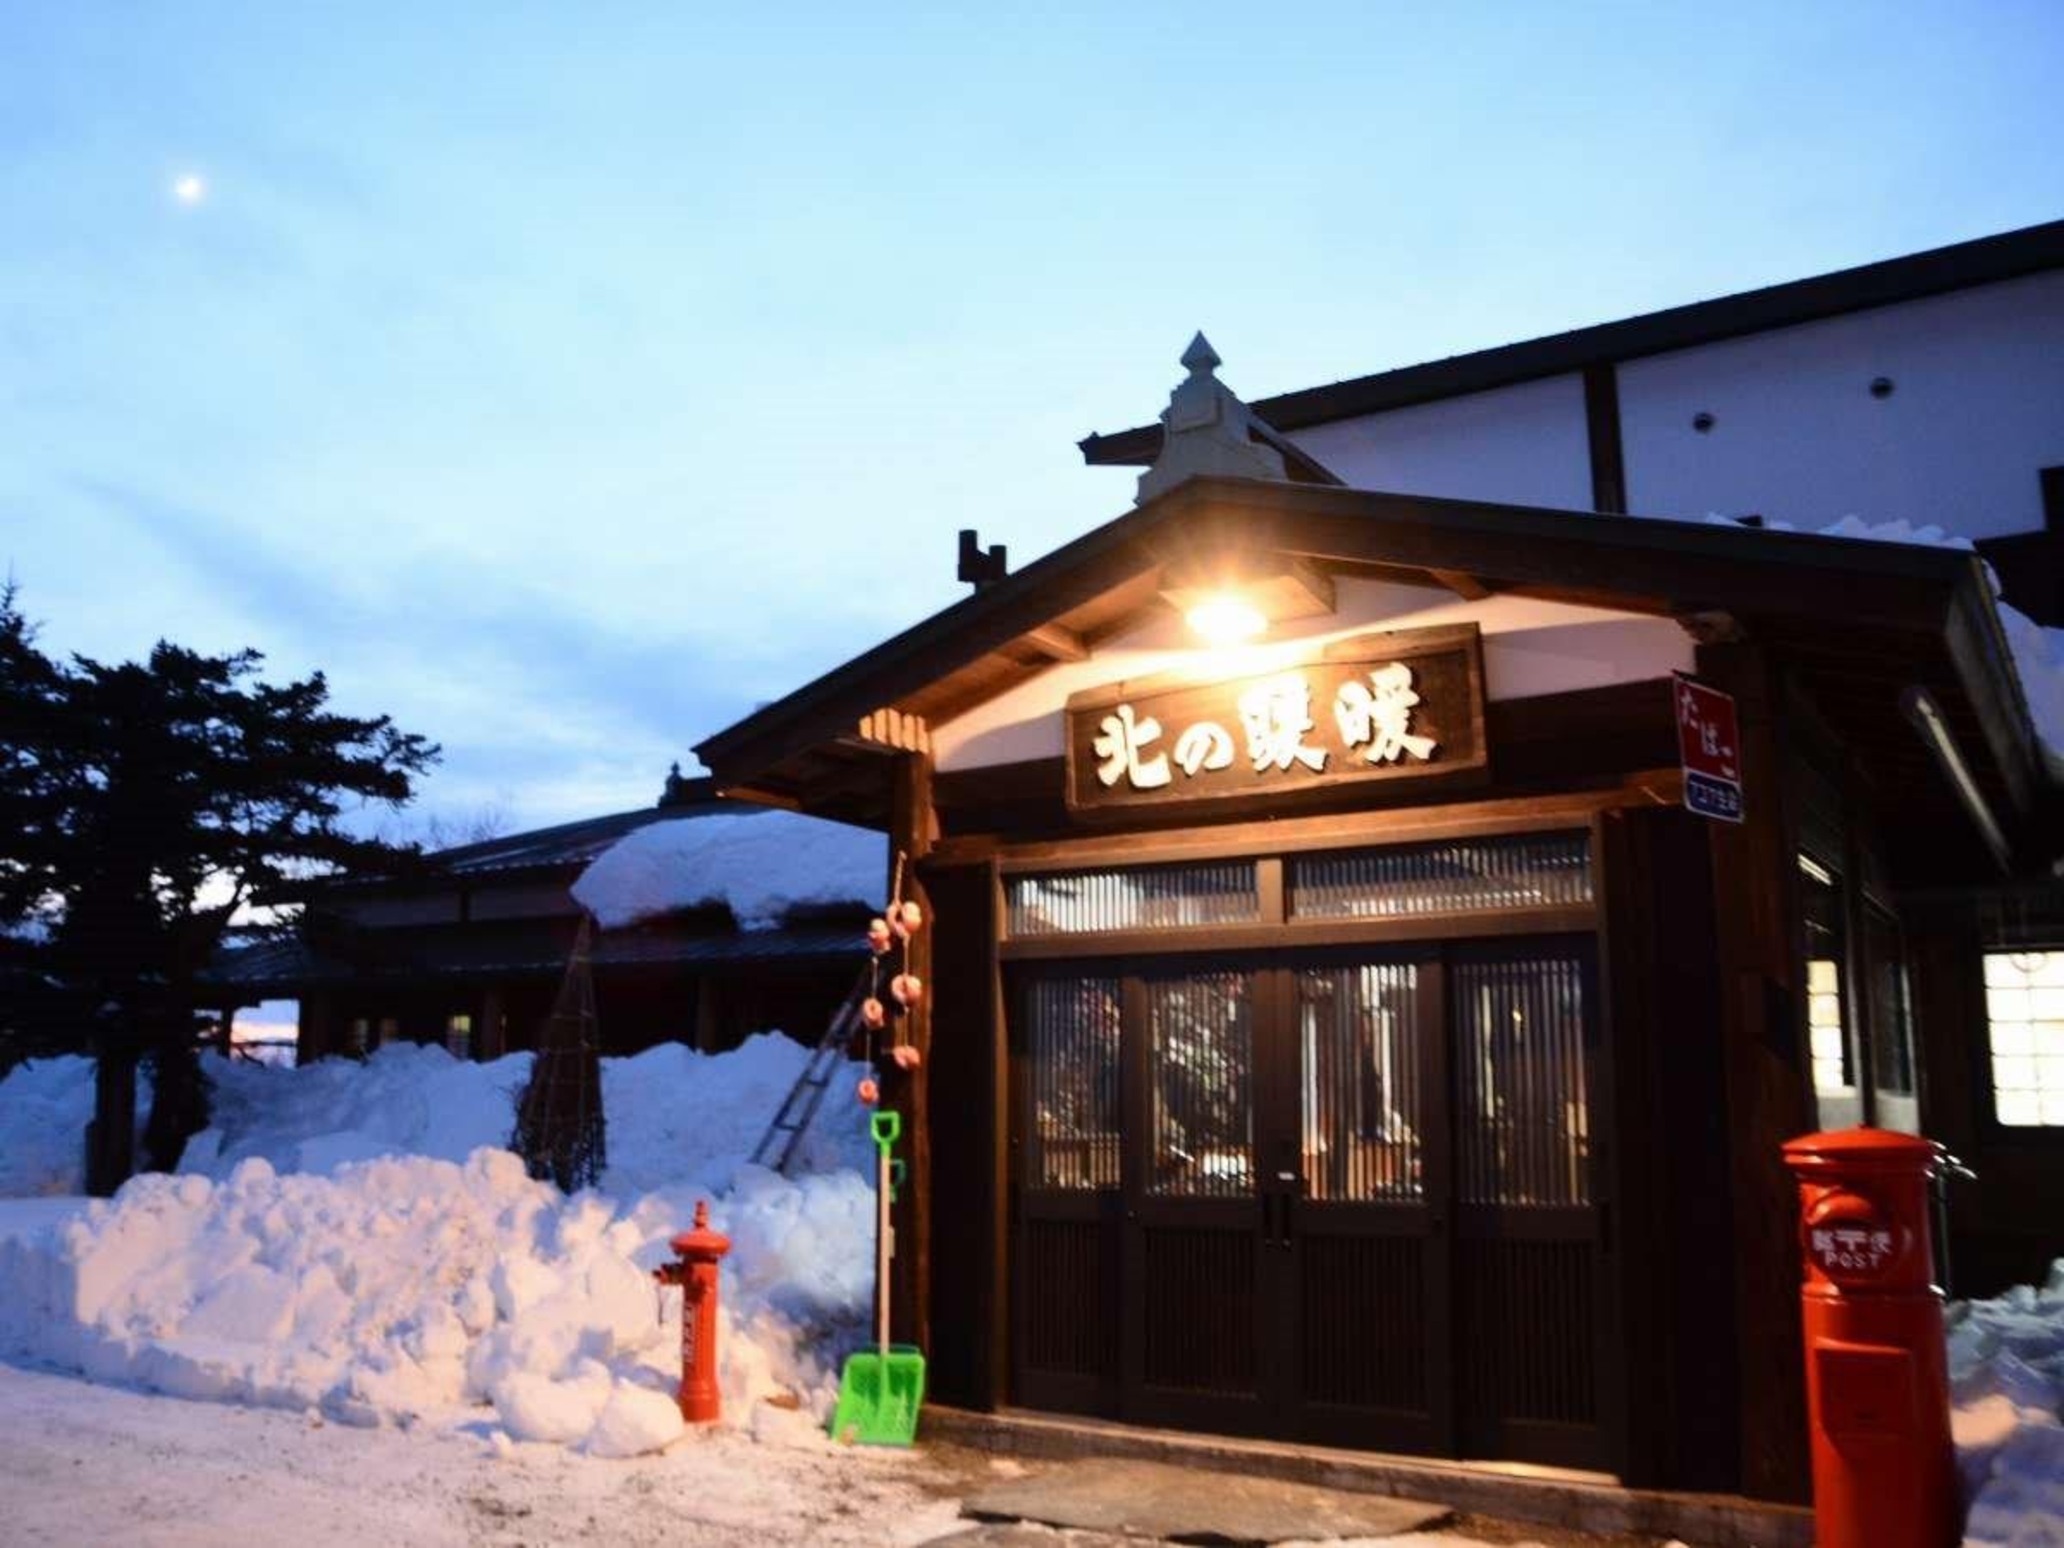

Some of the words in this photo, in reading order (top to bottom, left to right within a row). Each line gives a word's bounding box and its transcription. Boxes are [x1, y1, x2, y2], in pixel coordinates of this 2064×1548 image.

[1681, 688, 1735, 777] たばこ
[1825, 1251, 1880, 1269] POST
